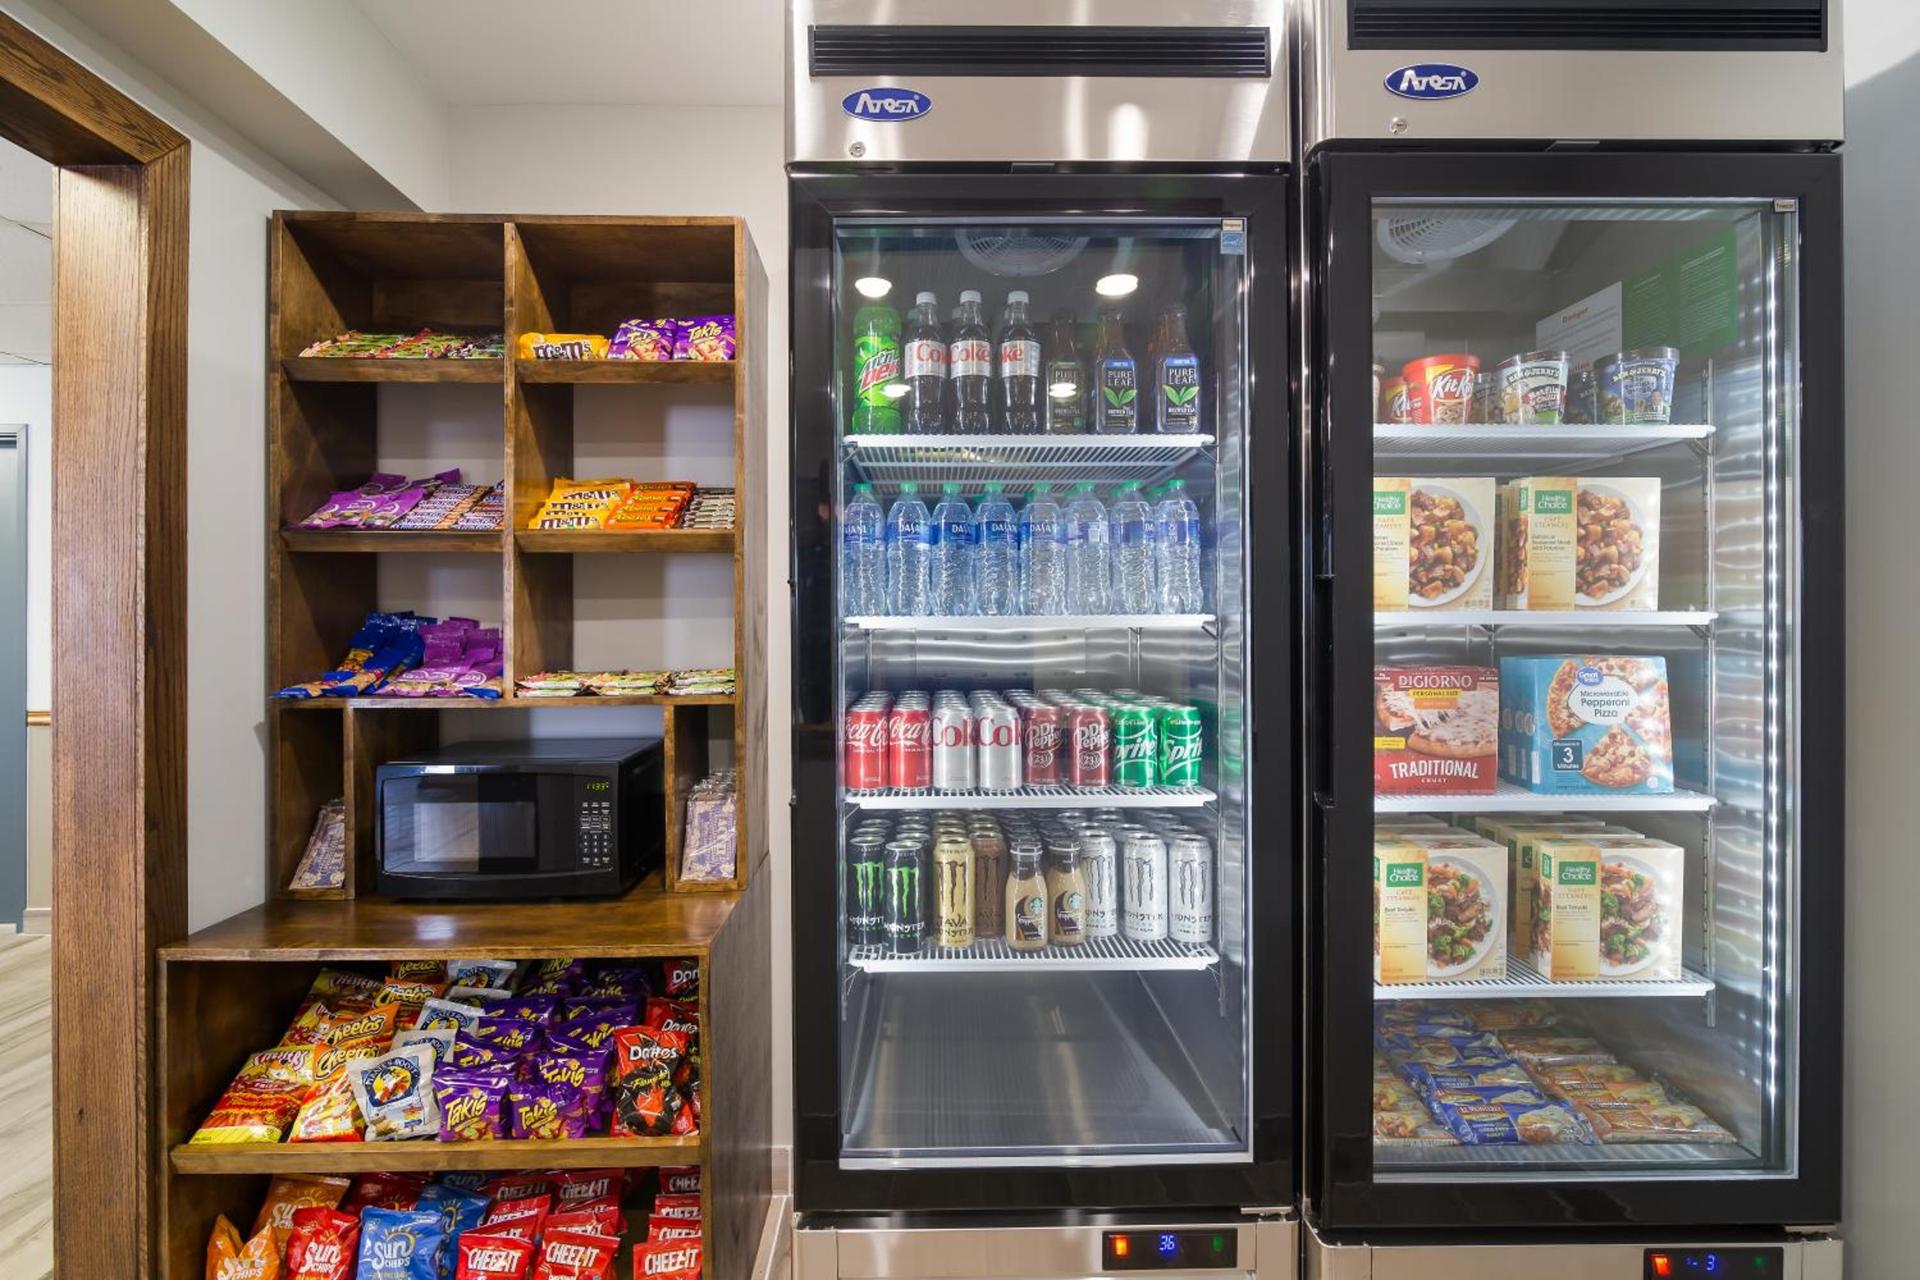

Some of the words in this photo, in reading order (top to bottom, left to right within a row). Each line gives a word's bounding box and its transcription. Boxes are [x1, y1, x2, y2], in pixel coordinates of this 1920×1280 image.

[1581, 698, 1630, 707] Pepperoni
[1594, 709, 1618, 718] Pizza
[1562, 747, 1574, 764] 3
[1389, 759, 1479, 779] TRADITIONAL
[1561, 873, 1592, 881] Choice
[629, 1045, 679, 1061] Doritos
[445, 1095, 488, 1132] Takis
[519, 1102, 558, 1130] Takis
[1159, 1235, 1176, 1251] 36
